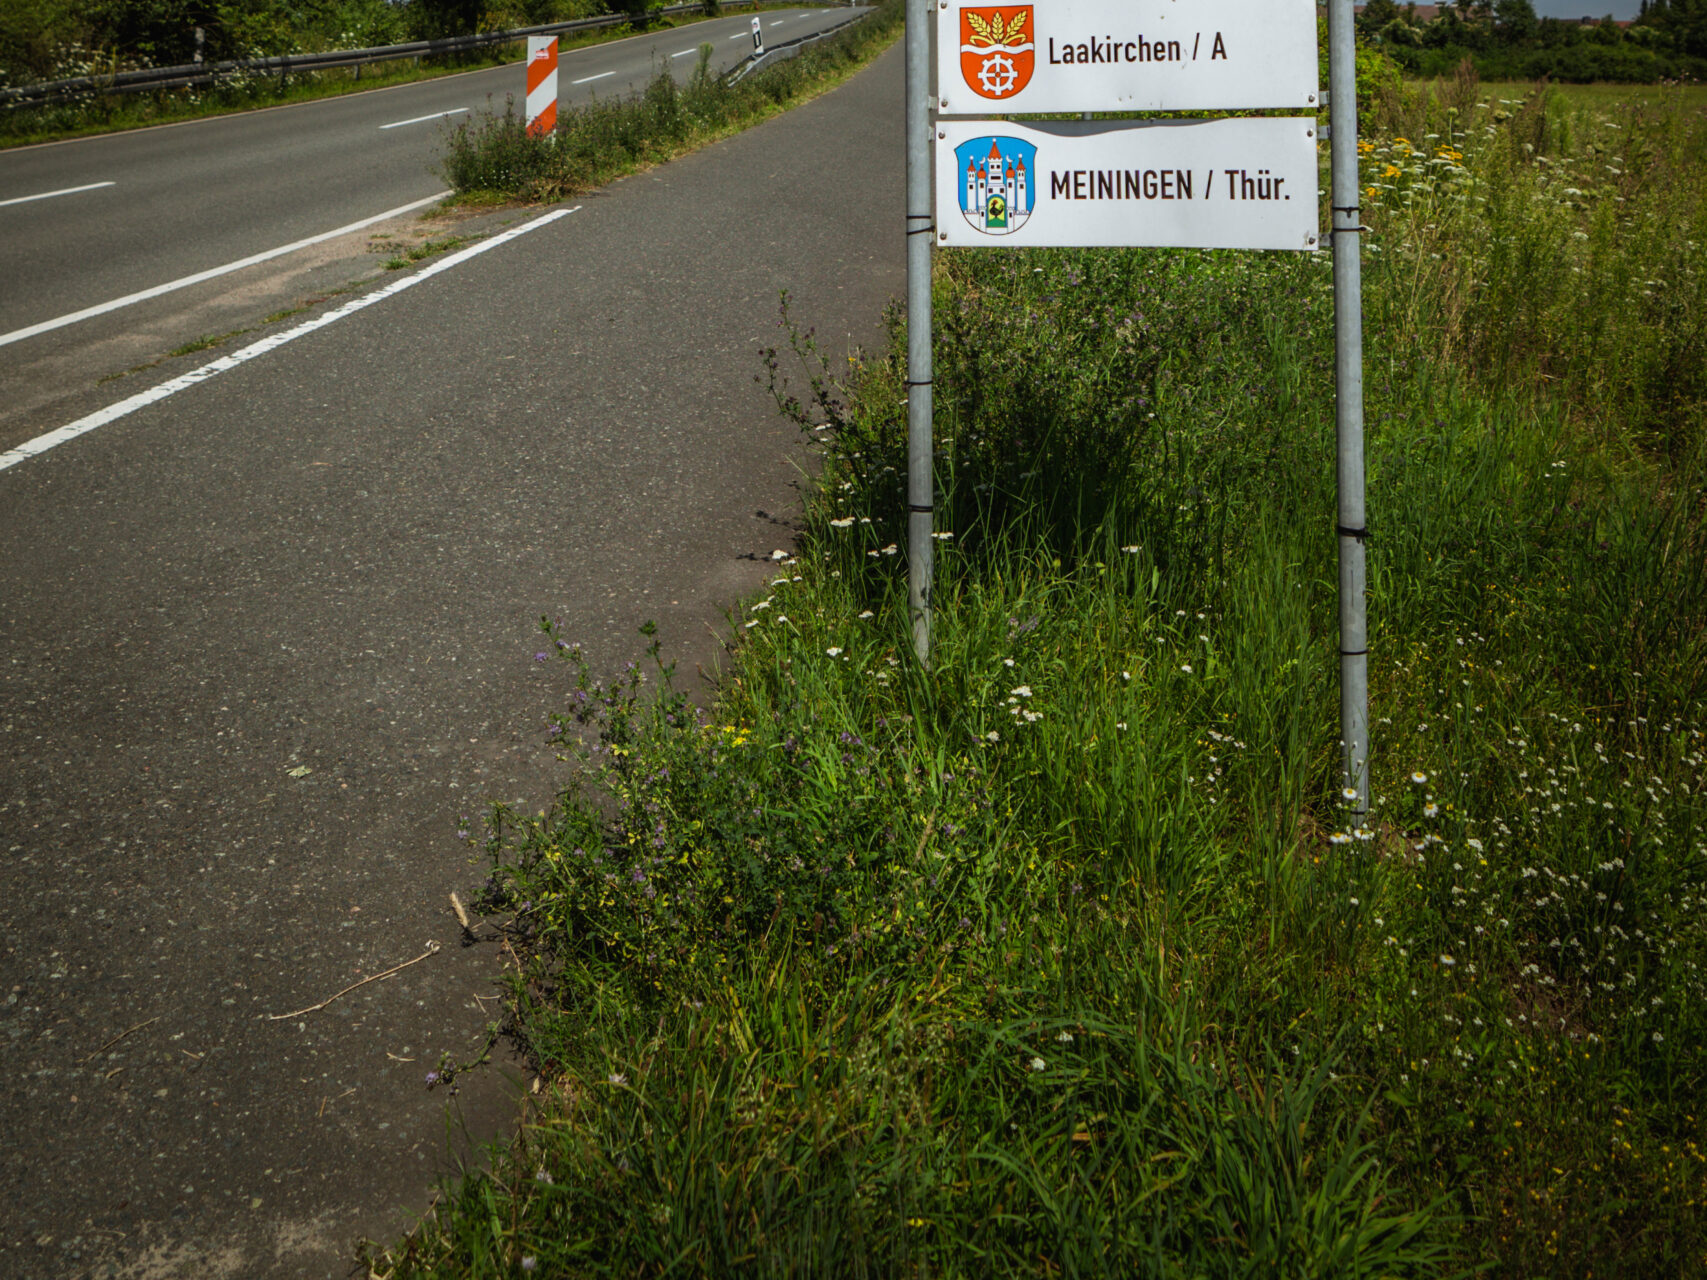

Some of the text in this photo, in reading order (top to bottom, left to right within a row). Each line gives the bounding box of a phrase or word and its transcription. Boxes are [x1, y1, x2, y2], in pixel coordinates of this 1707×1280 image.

[1048, 31, 1228, 65] Laakirchen / A
[1051, 169, 1290, 201] MEININGEN / Thür.
